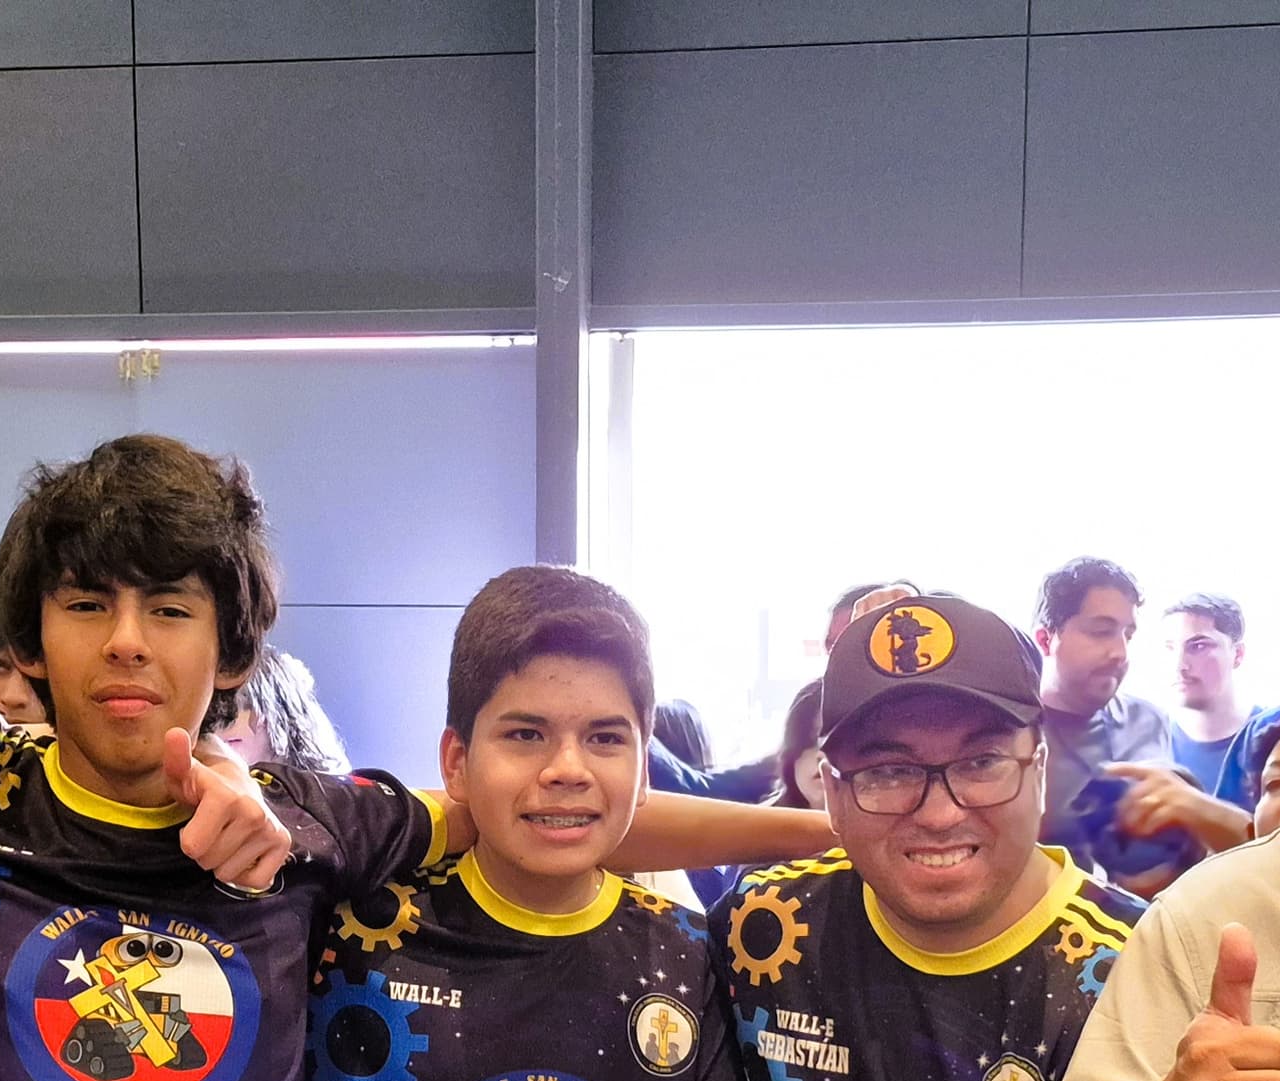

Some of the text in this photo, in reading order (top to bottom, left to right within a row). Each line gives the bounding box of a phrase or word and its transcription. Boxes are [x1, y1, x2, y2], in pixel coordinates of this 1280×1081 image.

[118, 909, 150, 927] SAN
[388, 981, 462, 1008] WALL-E
[776, 1009, 835, 1038] WALL-E
